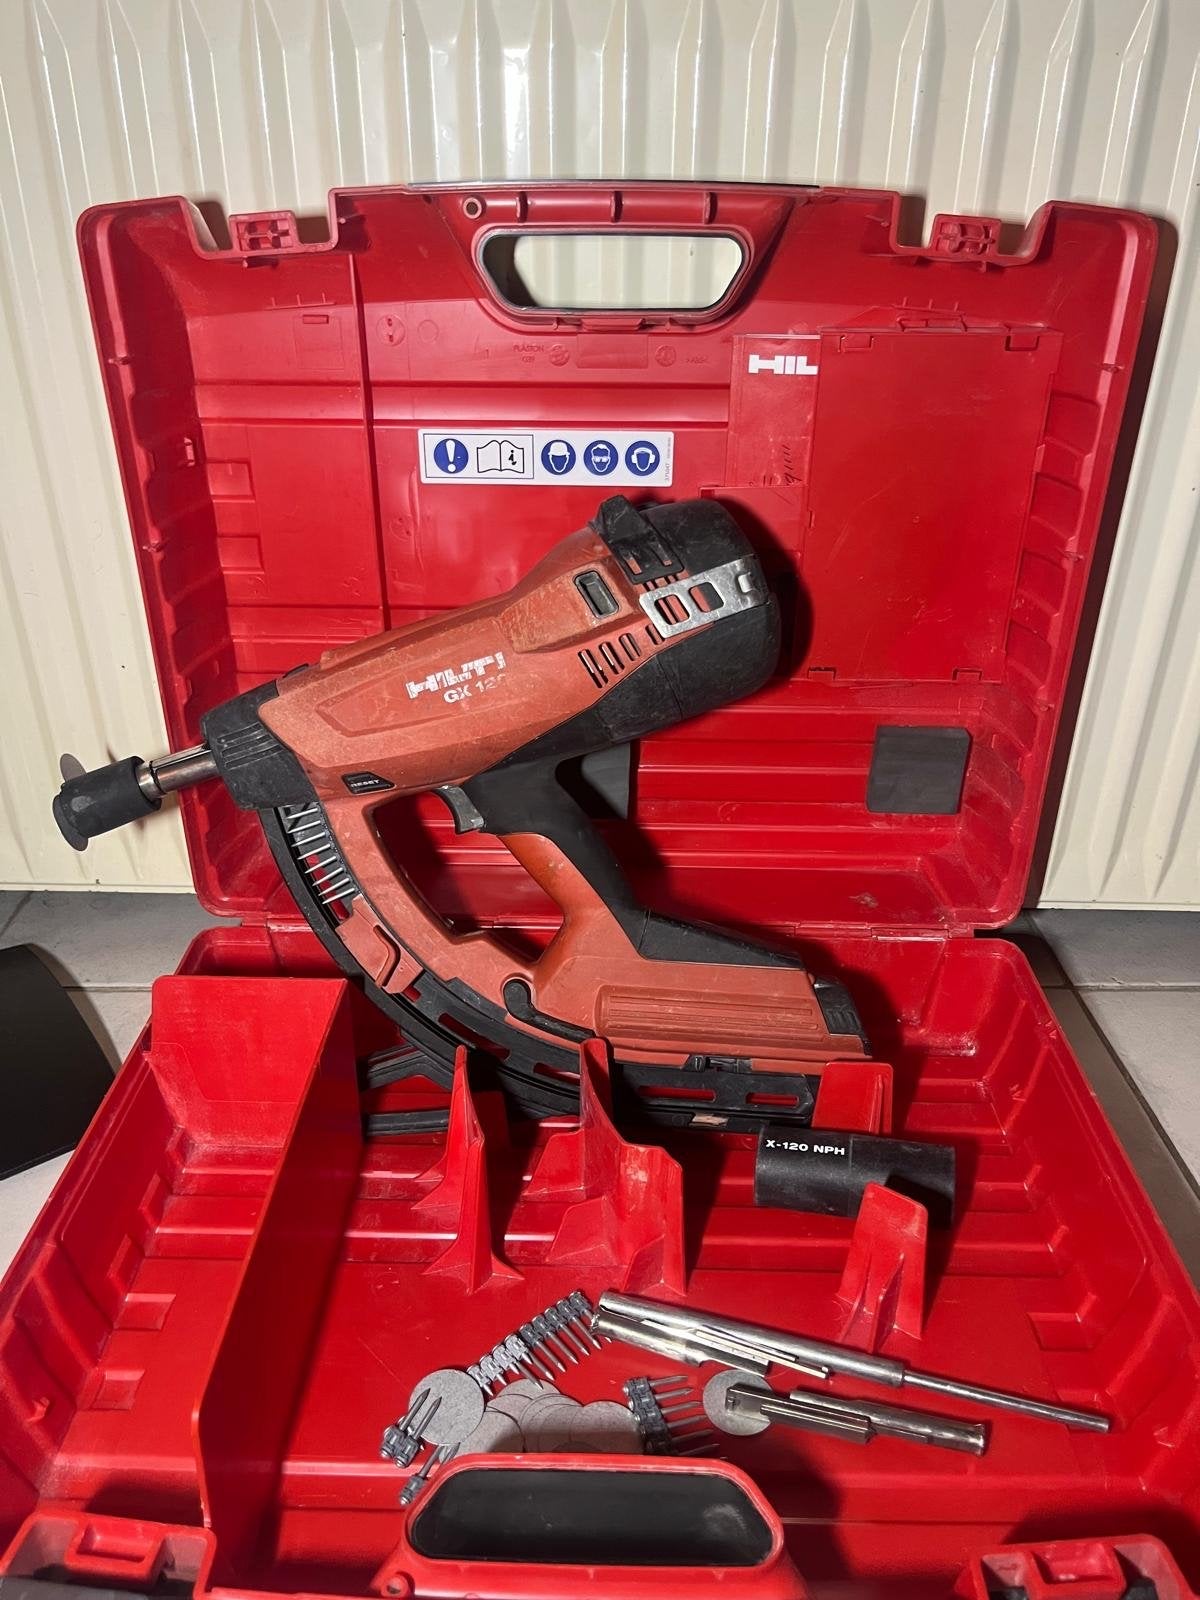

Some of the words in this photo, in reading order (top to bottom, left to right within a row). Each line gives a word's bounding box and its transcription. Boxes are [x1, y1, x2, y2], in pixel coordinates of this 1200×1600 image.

[748, 354, 819, 375] HIL
[405, 651, 507, 699] HILTI
[443, 683, 473, 704] GX
[350, 779, 380, 788] RESET
[765, 1139, 809, 1152] X-120
[813, 1144, 846, 1156] NPH
